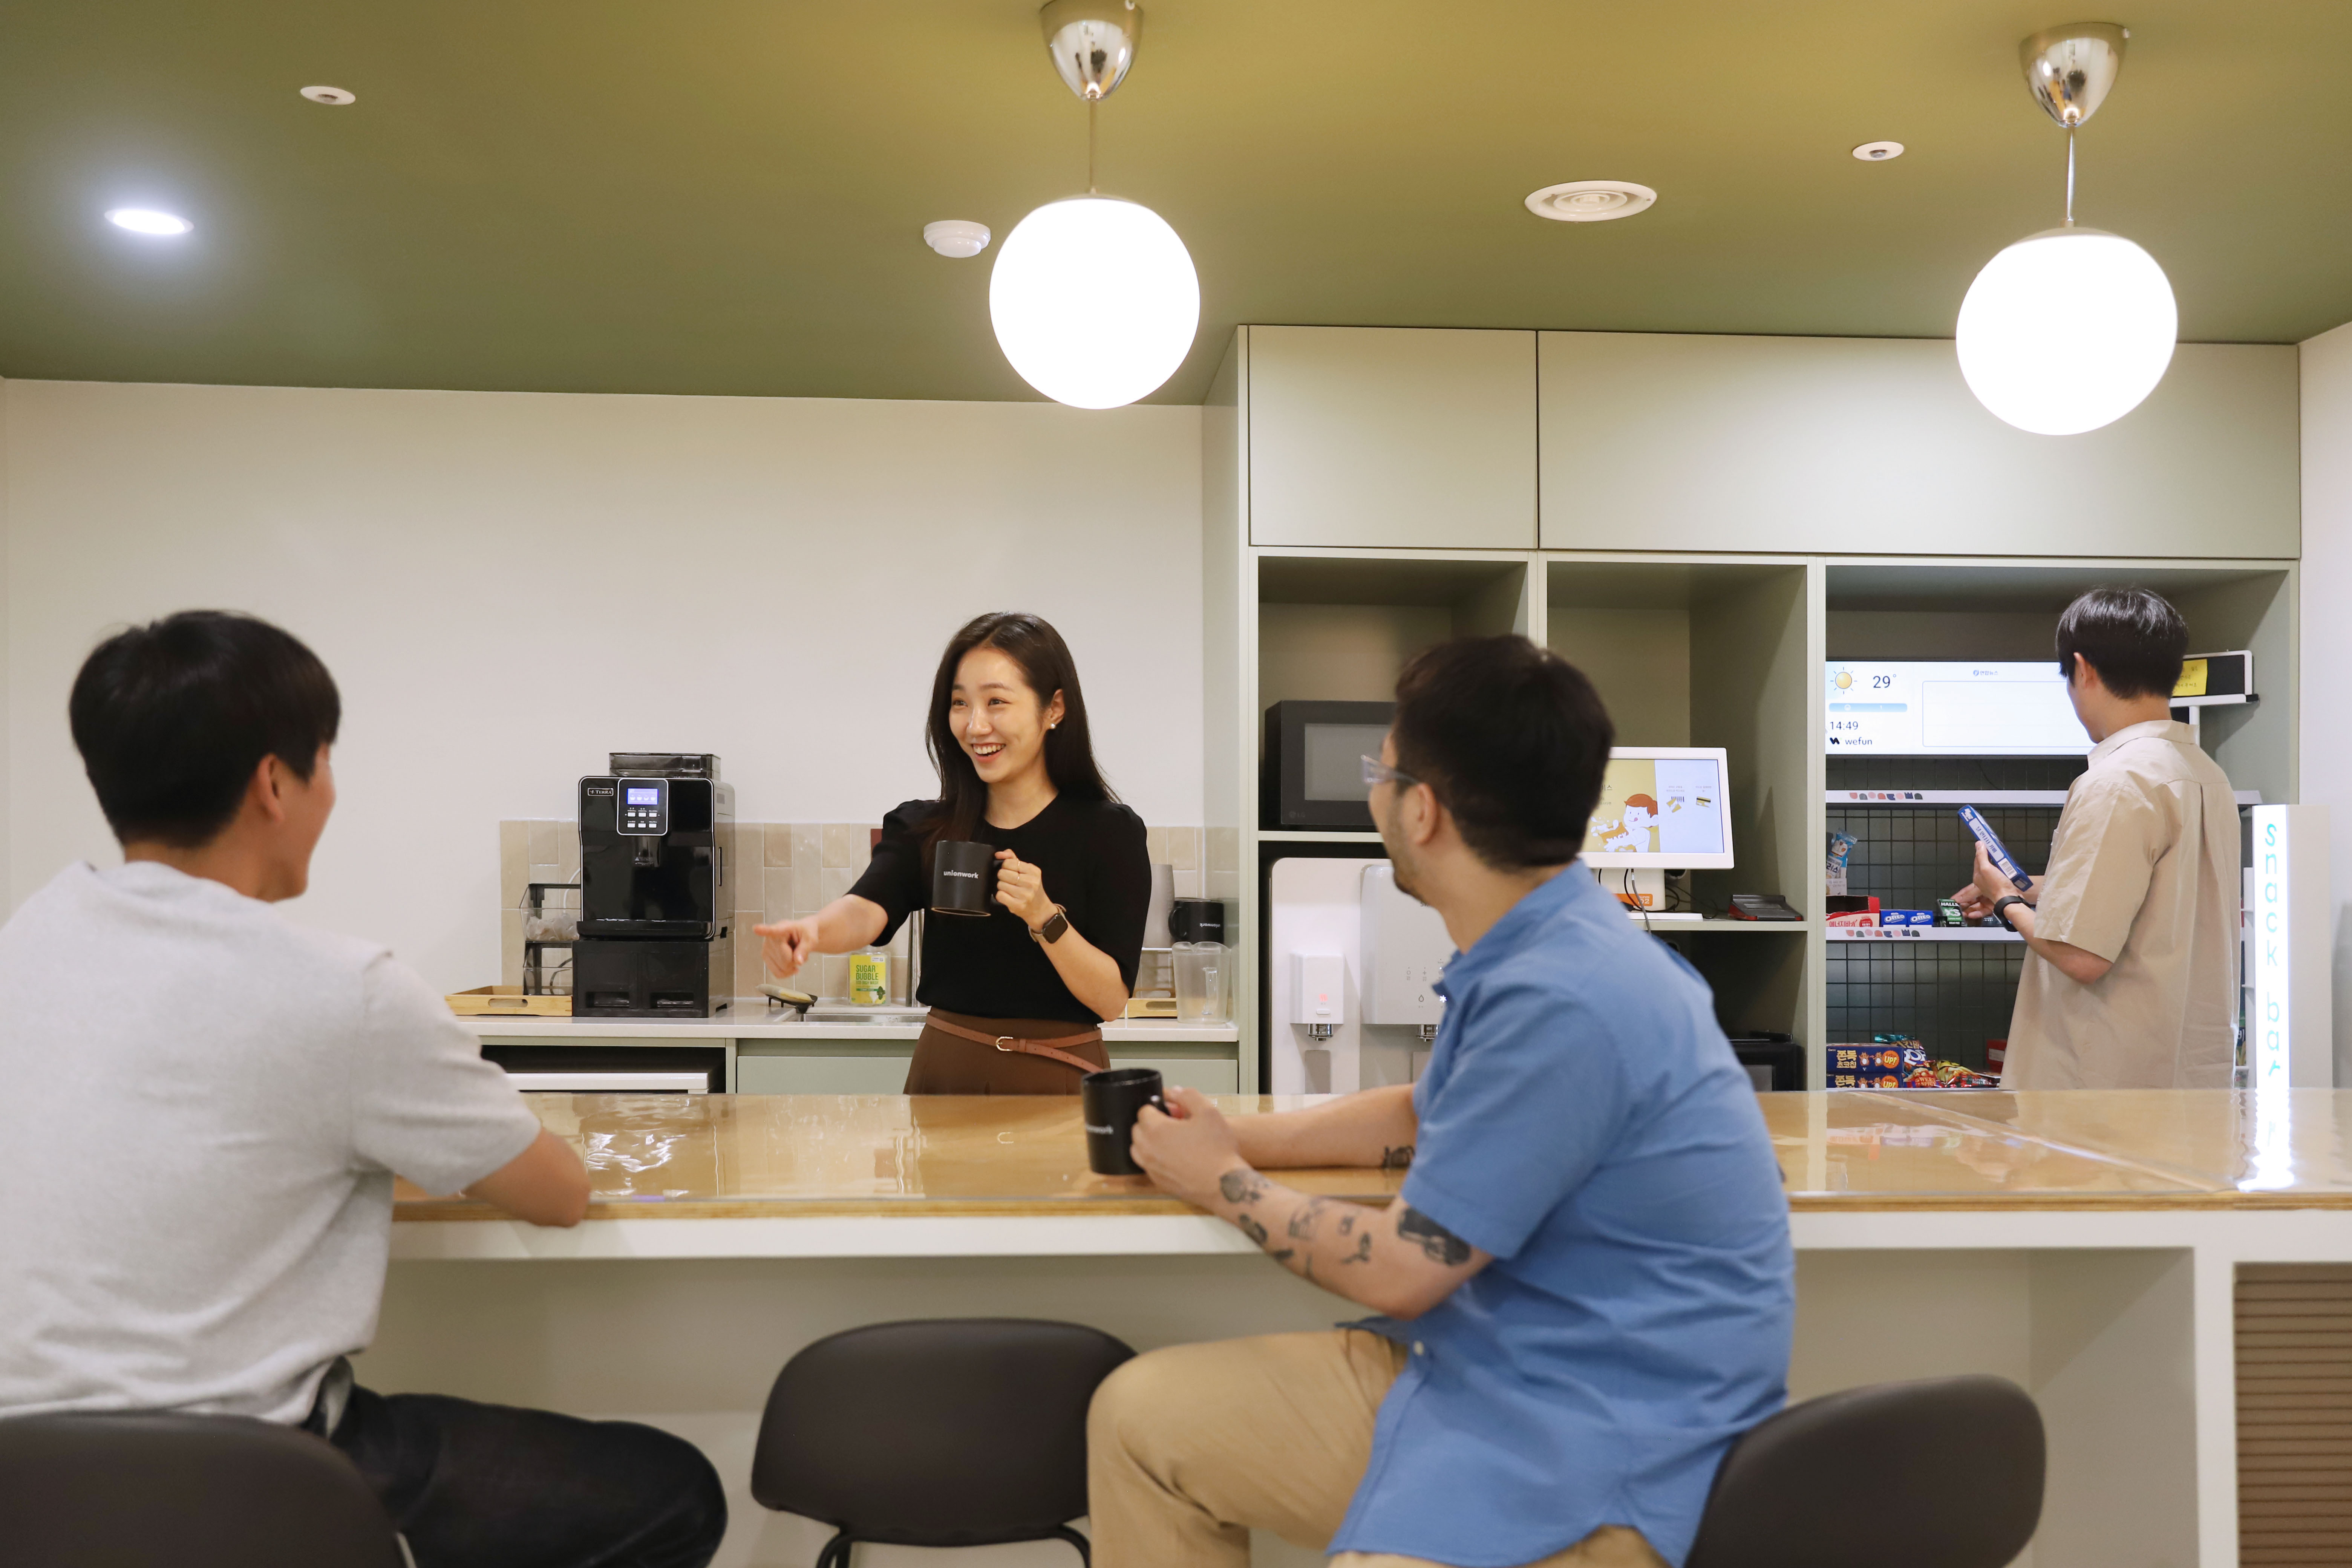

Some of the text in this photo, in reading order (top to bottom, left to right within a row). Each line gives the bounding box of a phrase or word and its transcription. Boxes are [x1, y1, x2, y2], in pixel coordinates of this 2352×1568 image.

[1830, 721, 1858, 730] 14:49
[1845, 737, 1872, 745] wefun
[943, 870, 979, 879] unionwork
[2264, 823, 2280, 1076] snack bar
